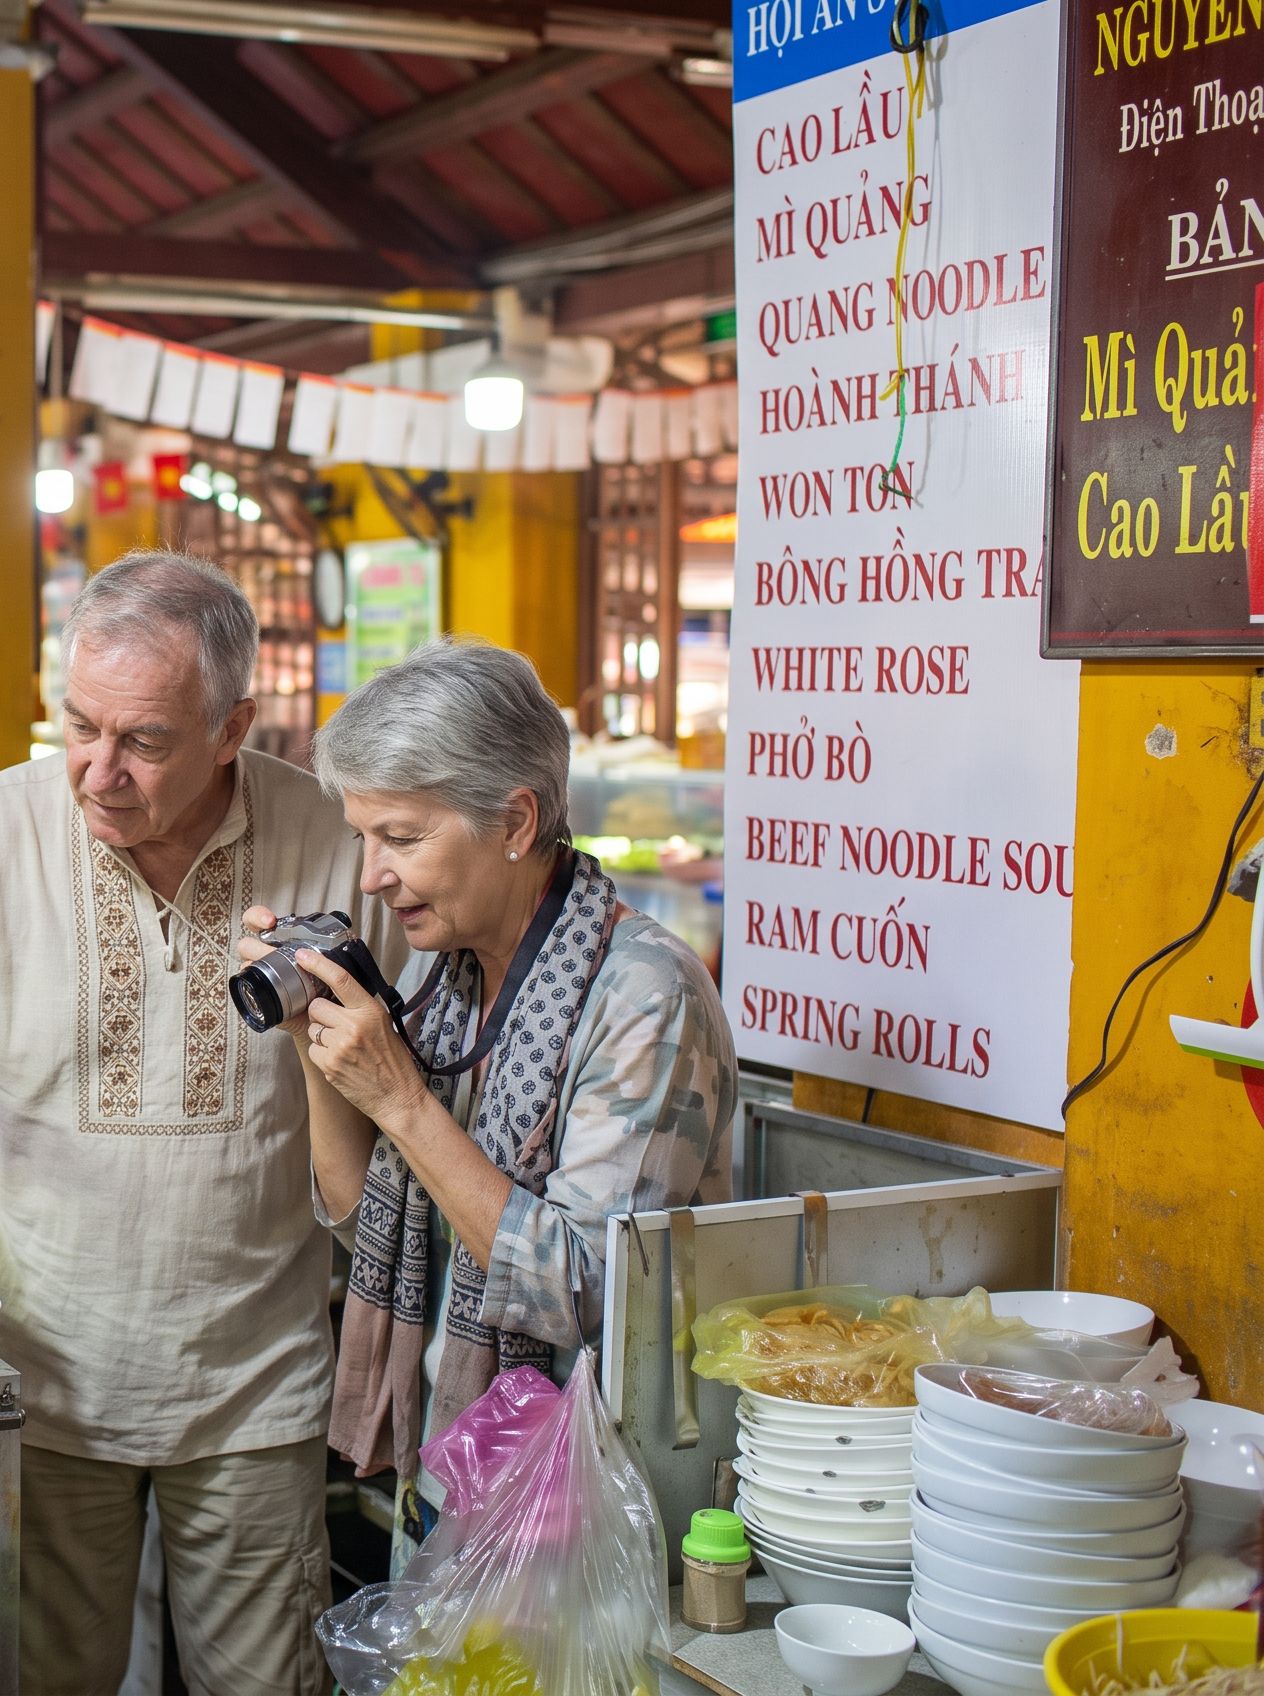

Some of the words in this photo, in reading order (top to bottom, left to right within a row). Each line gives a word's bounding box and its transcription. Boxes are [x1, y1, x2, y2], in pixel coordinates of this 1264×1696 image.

[756, 114, 822, 175] CAO
[831, 69, 905, 155] LẦU
[1119, 98, 1184, 157] Điện
[756, 195, 795, 263] MÌ
[805, 169, 933, 260] QUẢNG
[758, 281, 876, 358] QUANG
[886, 246, 1047, 326] NOODLE
[759, 367, 879, 435] HOÀNH
[888, 343, 1026, 418] THÁNH
[1080, 331, 1138, 422] Mì
[1154, 306, 1257, 434] Quả
[759, 469, 834, 522] WON
[843, 461, 915, 515] TON
[1077, 471, 1160, 560] Cao
[754, 545, 848, 606] BÔNG
[857, 526, 965, 603] HỒNG
[751, 646, 864, 693] WHITE
[873, 645, 971, 695] ROSE
[747, 715, 816, 780] PHỞ
[824, 720, 872, 784] BÒ
[745, 816, 831, 868] BEEF
[839, 824, 992, 888] NOODLE
[745, 900, 821, 955] RAM
[830, 896, 931, 975] CUỐN
[740, 984, 862, 1052] SPRING
[871, 1008, 992, 1080] ROLLS
